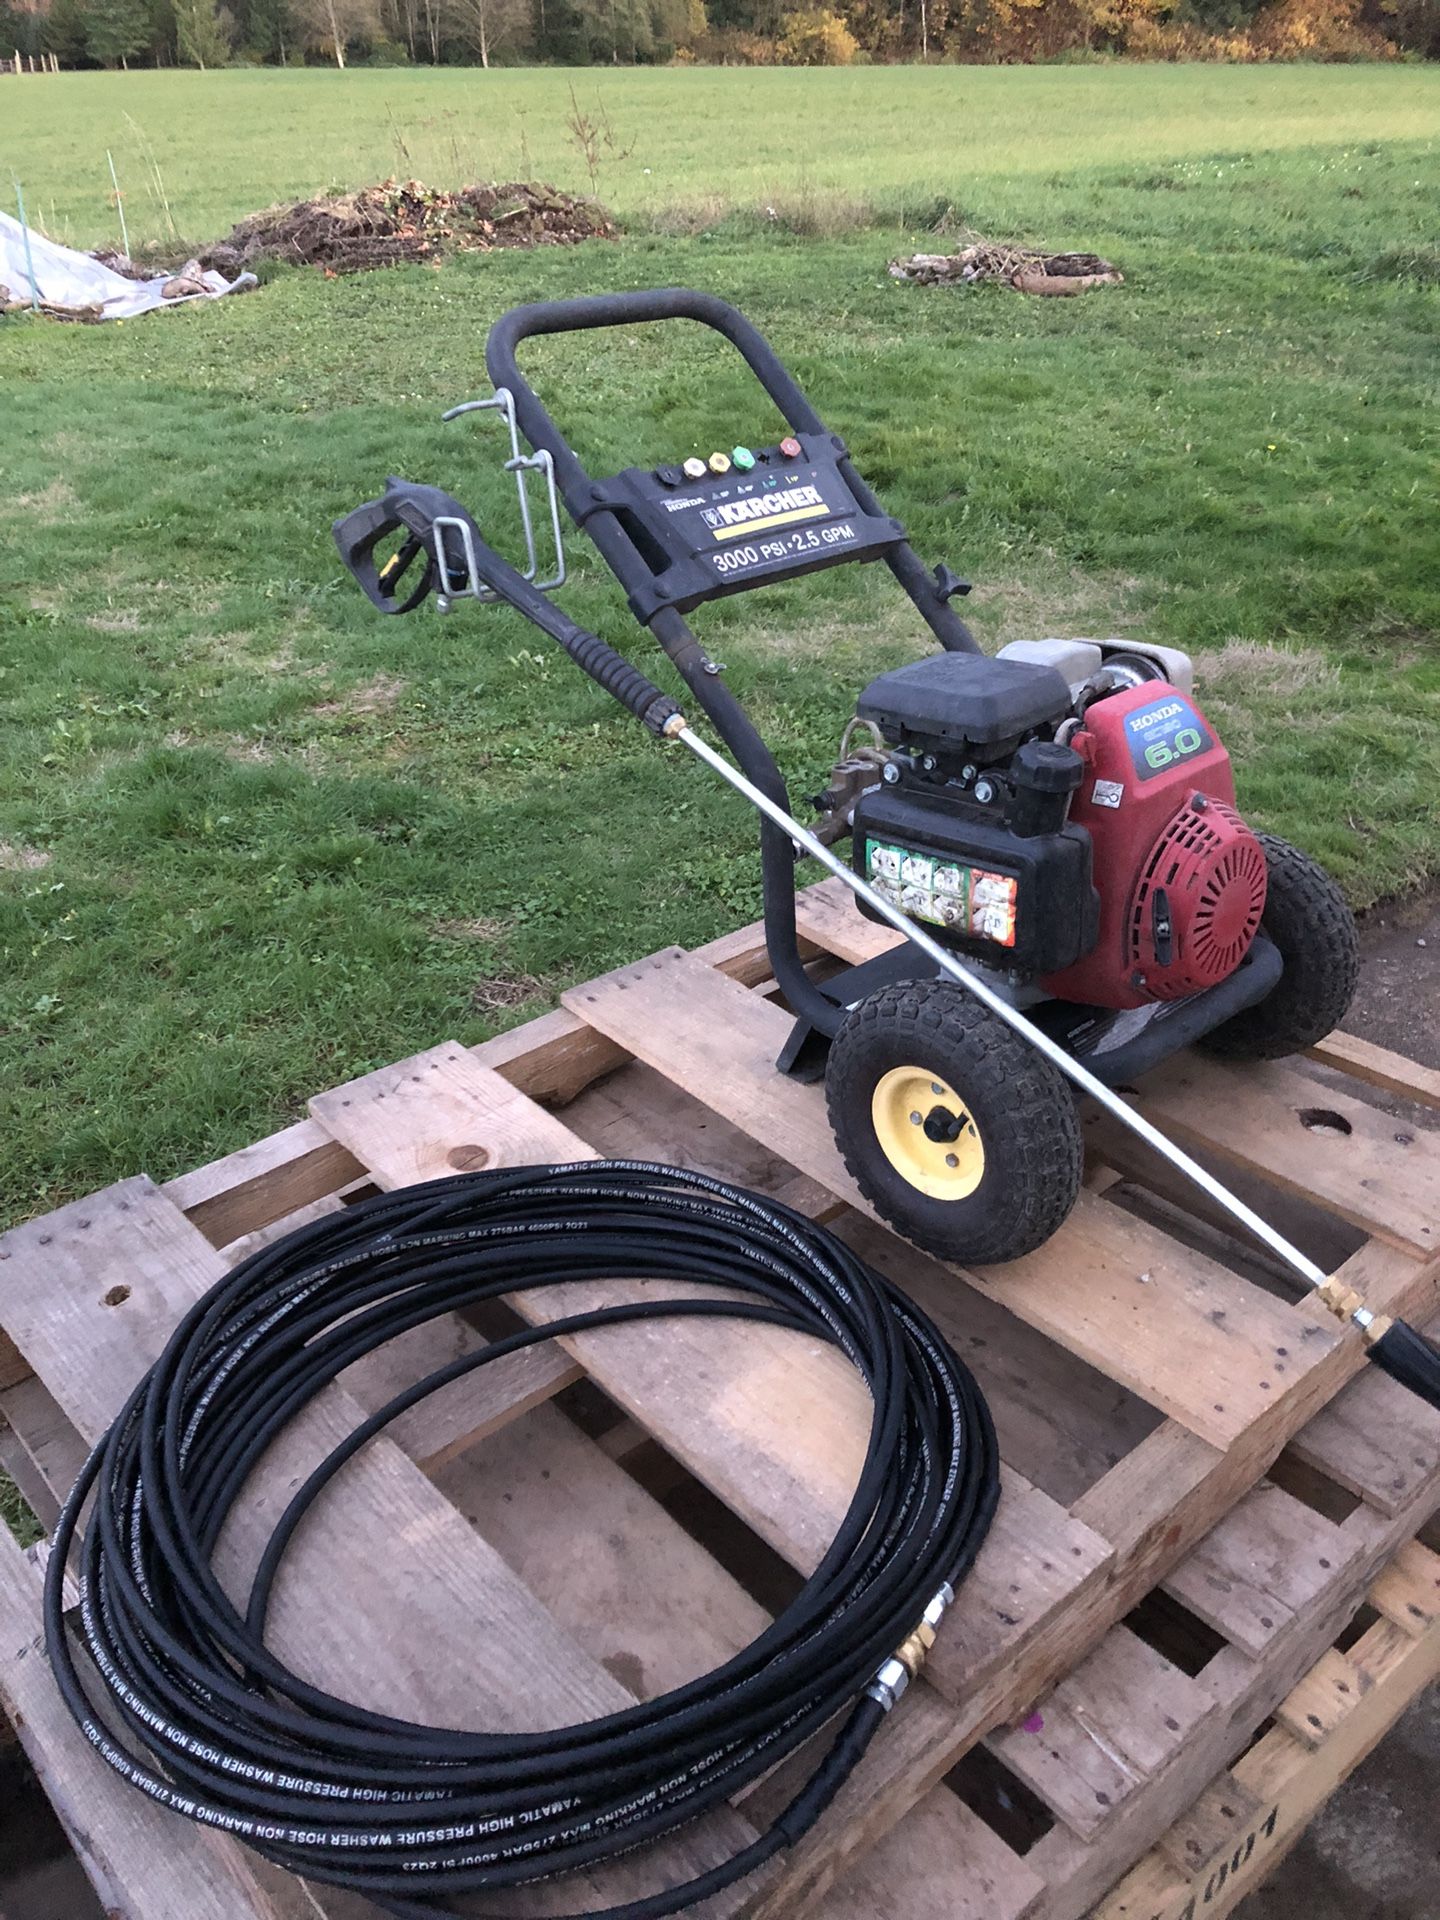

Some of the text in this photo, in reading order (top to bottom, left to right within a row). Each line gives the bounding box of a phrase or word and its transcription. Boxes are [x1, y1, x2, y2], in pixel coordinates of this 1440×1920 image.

[667, 497, 706, 512] HONDA
[713, 546, 759, 572] 3000
[760, 541, 787, 559] PSI
[792, 531, 820, 551] 2.5
[821, 525, 855, 543] GPM
[1129, 703, 1183, 733] HONDA
[1144, 728, 1201, 769] 6.0
[614, 1160, 659, 1173] PRESSURE
[660, 1166, 696, 1182] WASHER
[696, 1177, 720, 1191] HOSE
[720, 1186, 738, 1200] NON
[737, 1195, 772, 1222] MARKING
[771, 1218, 788, 1235] MAX
[467, 1228, 488, 1237] MAX
[130, 1540, 145, 1583] WASHER
[90, 1639, 113, 1674] 275BAR
[109, 1672, 128, 1695] MAX
[124, 1692, 165, 1731] MARKING
[164, 1726, 188, 1746] NON
[188, 1740, 220, 1763] HOSE
[221, 1756, 274, 1783] WASHER
[130, 1769, 169, 1800] 275BAR
[276, 1774, 349, 1797] PRESSURE
[352, 1787, 387, 1800] HIGH
[169, 1793, 195, 1813] MAX
[518, 1797, 581, 1823] YAMATIC
[196, 1806, 253, 1833] MARKING
[478, 1815, 514, 1833] HIGH
[255, 1824, 284, 1839] NON
[288, 1830, 326, 1844] HOSE
[330, 1833, 391, 1846] WASHER
[397, 1824, 474, 1844] PRESSURE
